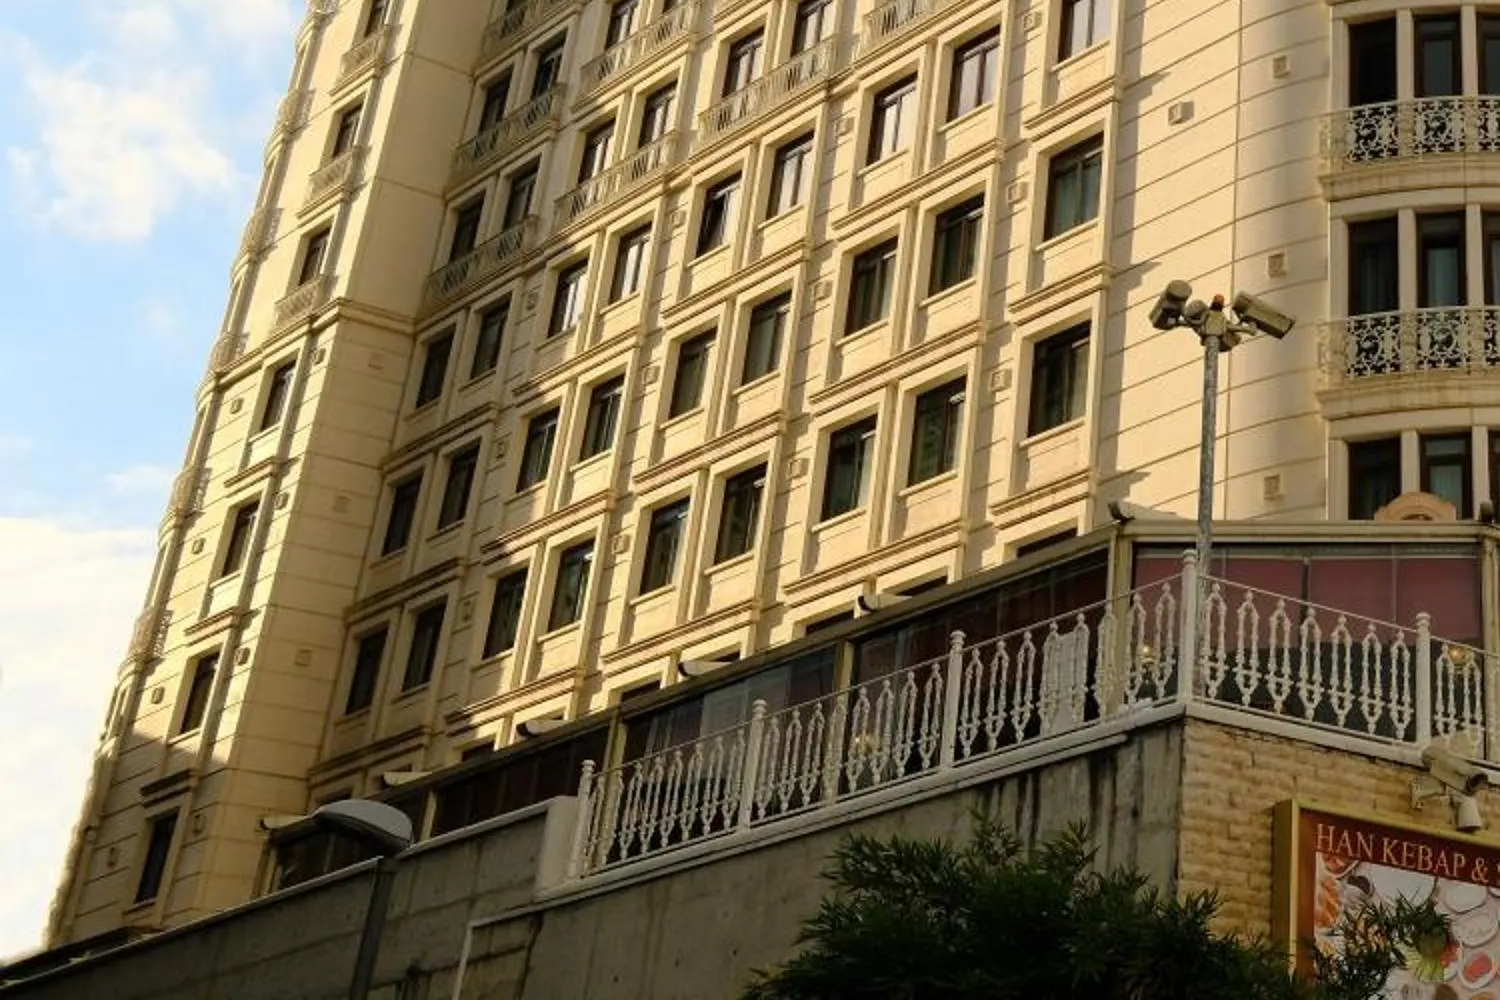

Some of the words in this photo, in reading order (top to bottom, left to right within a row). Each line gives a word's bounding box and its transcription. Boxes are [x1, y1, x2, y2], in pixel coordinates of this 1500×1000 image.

[1316, 822, 1375, 861] HAN
[1382, 836, 1467, 879] KEBAP
[1471, 856, 1489, 884] &
